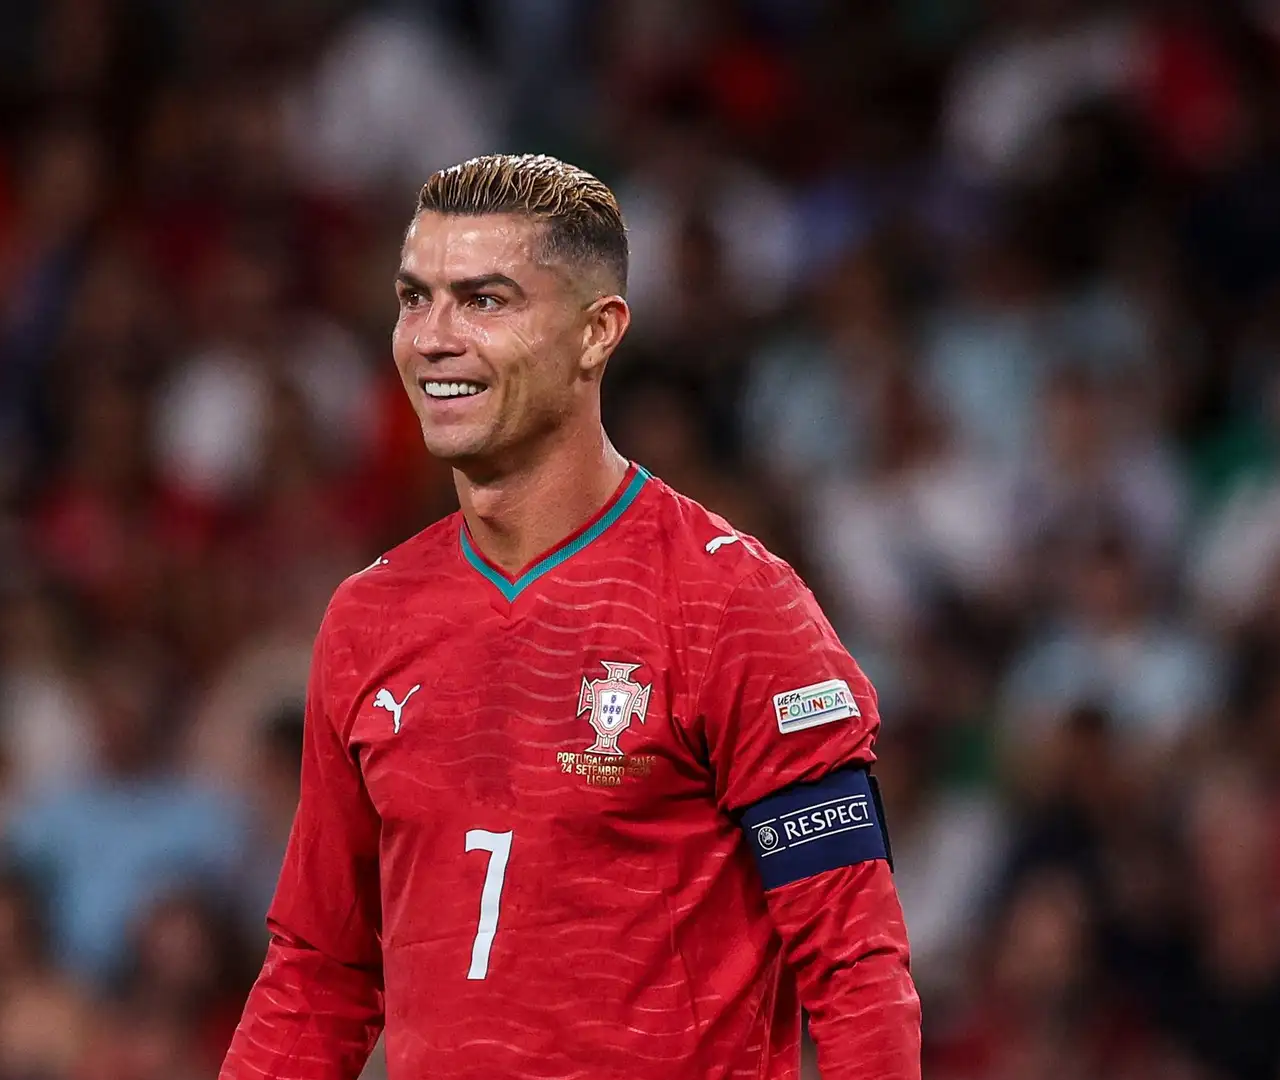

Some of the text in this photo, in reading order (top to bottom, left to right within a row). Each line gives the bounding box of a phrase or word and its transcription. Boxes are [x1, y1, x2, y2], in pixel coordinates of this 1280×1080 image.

[777, 692, 801, 706] UEFA
[561, 763, 573, 773] 24
[576, 764, 625, 776] SETEMBRO
[587, 775, 622, 785] LISBOA
[783, 801, 870, 841] RESPECT
[465, 829, 513, 980] 7
